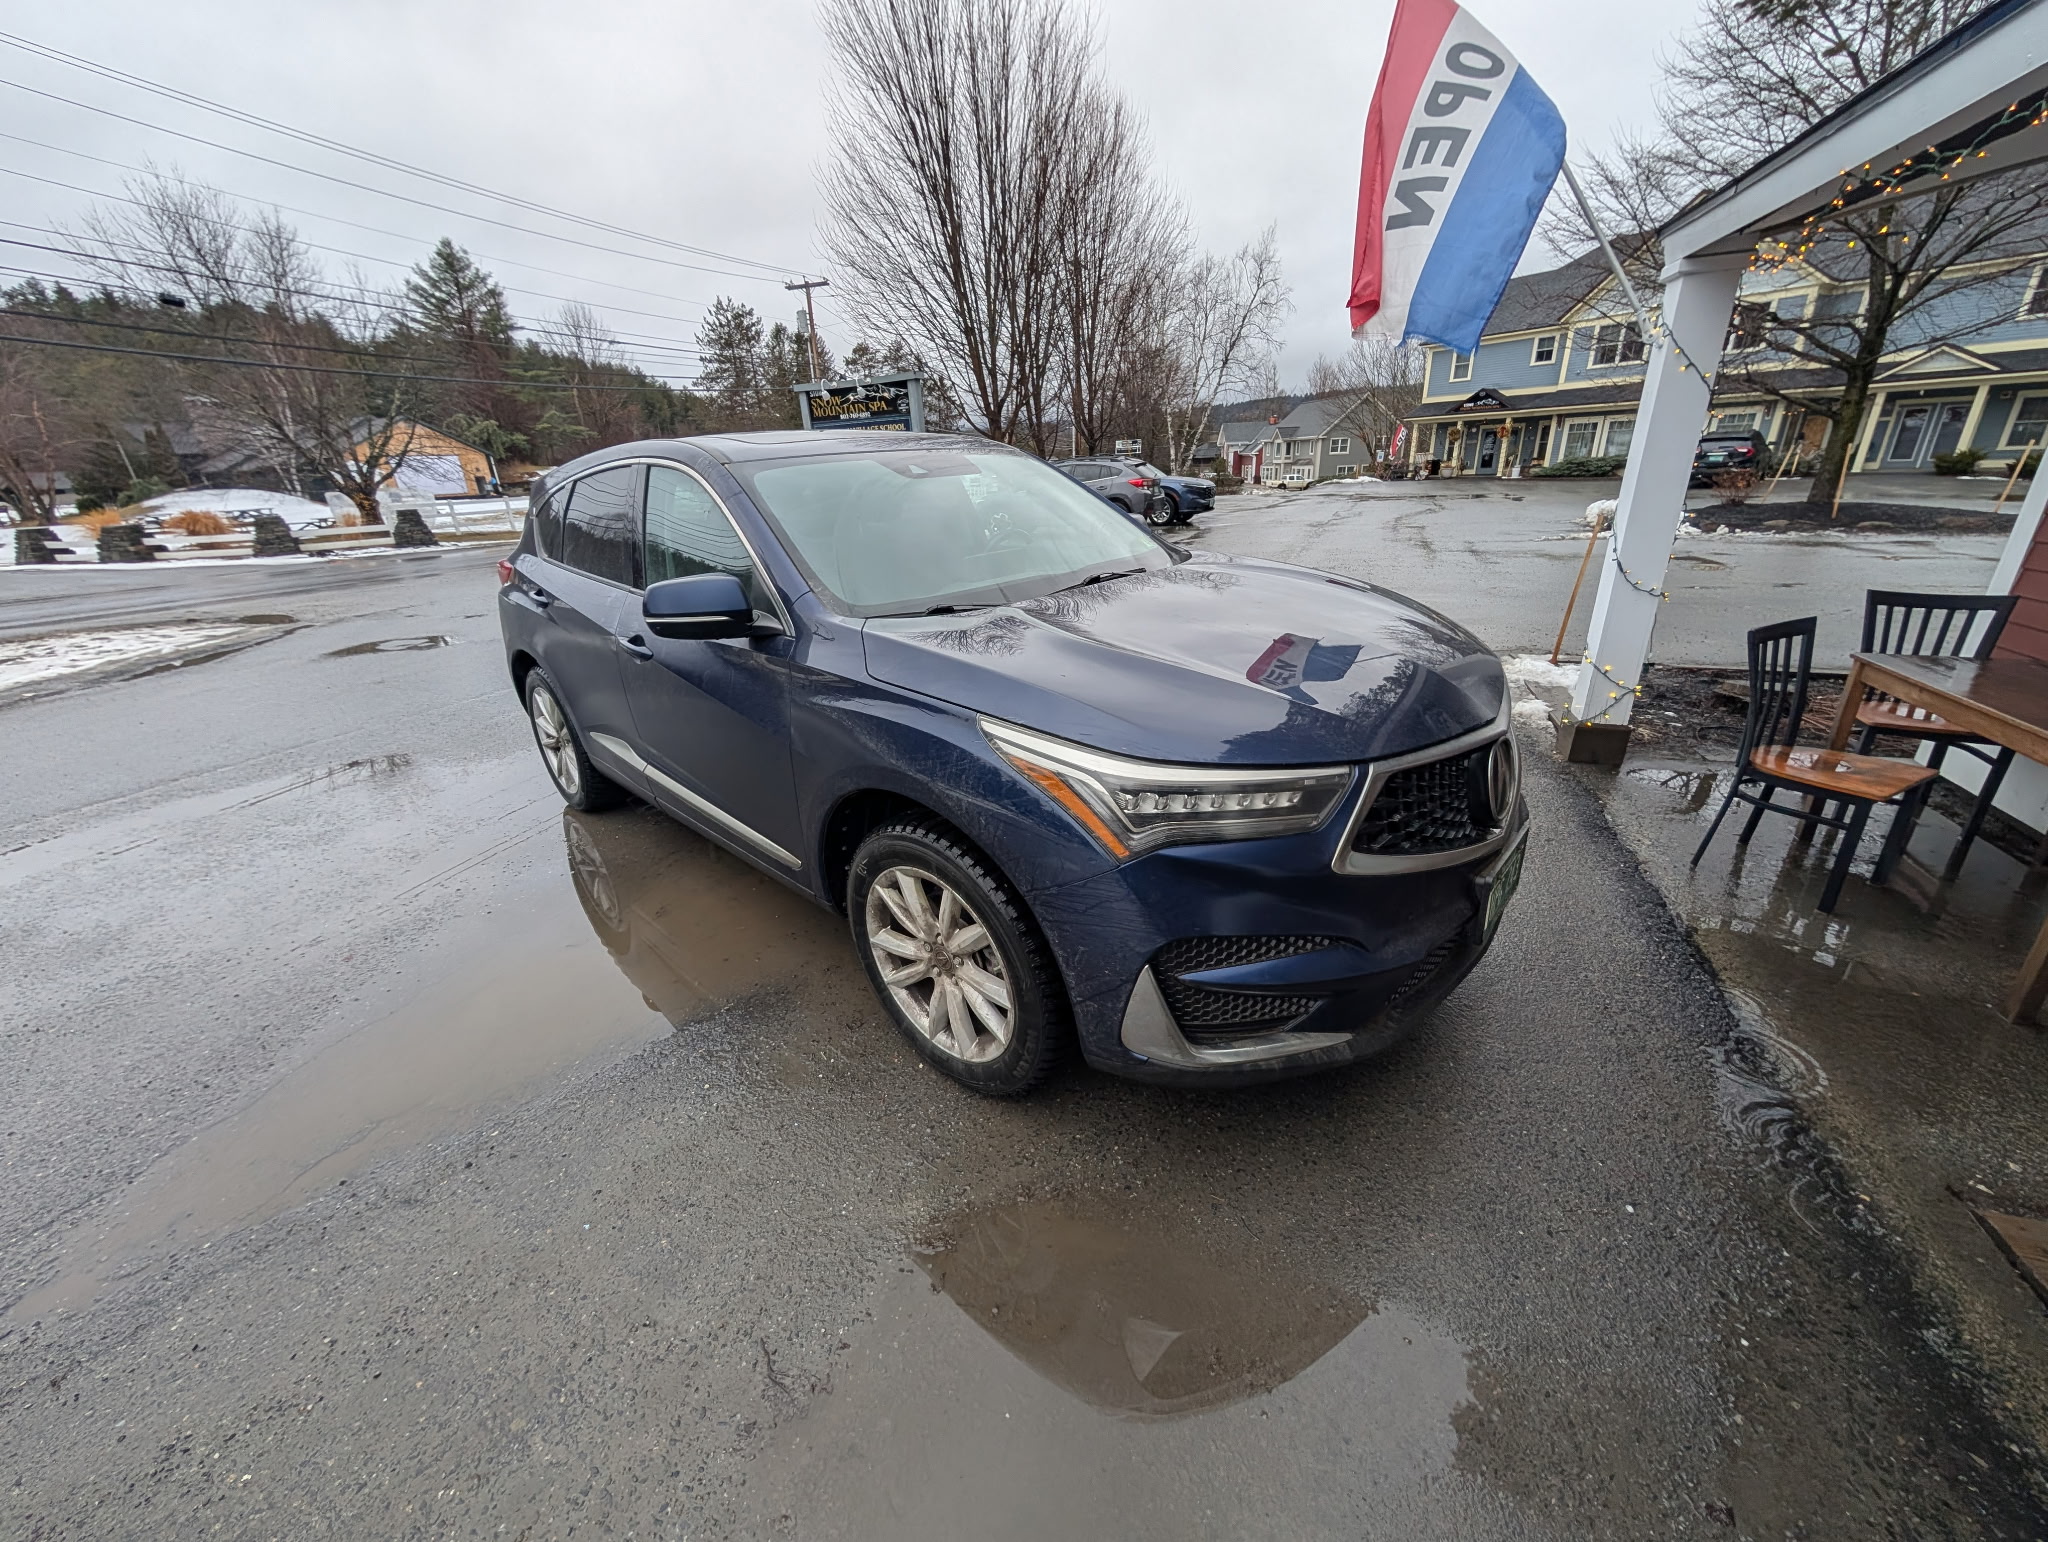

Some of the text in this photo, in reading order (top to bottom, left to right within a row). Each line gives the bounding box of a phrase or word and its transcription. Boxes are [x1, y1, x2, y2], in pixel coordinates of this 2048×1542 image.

[811, 396, 840, 408] SNOW
[813, 403, 866, 417] MOUNTAIN
[868, 401, 887, 411] SPA
